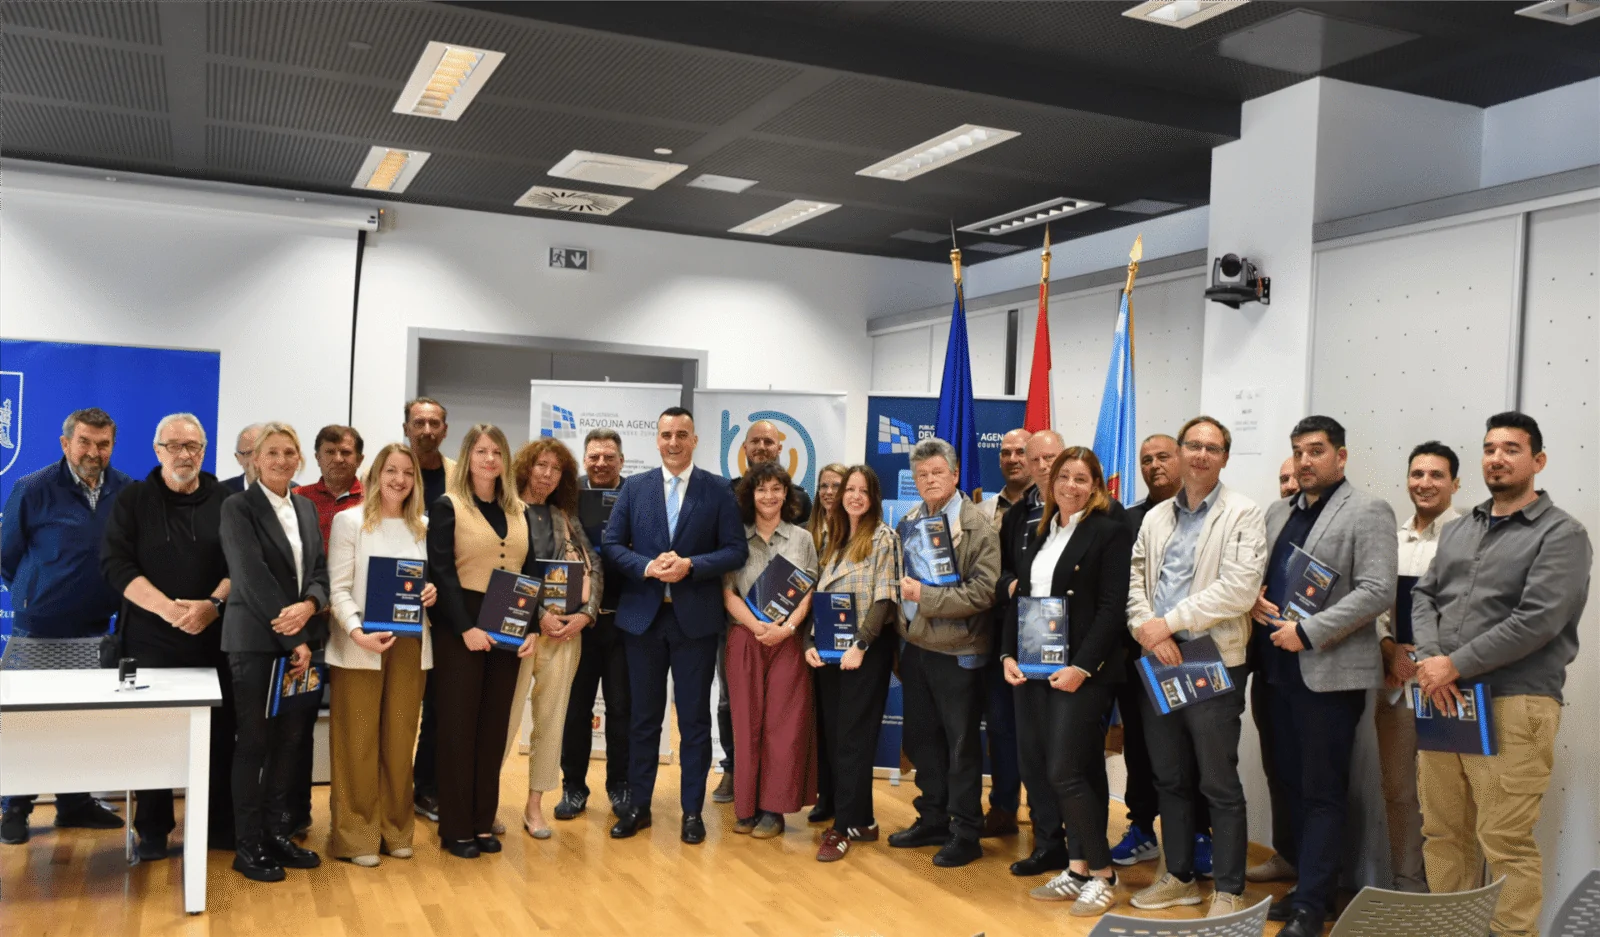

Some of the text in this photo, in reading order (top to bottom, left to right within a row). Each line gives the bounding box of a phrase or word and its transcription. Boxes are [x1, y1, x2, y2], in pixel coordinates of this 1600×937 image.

[579, 418, 659, 430] RAZVOJNA AGENCI
[918, 430, 1004, 442] DEV AGEN
[977, 441, 1001, 449] COUNT
